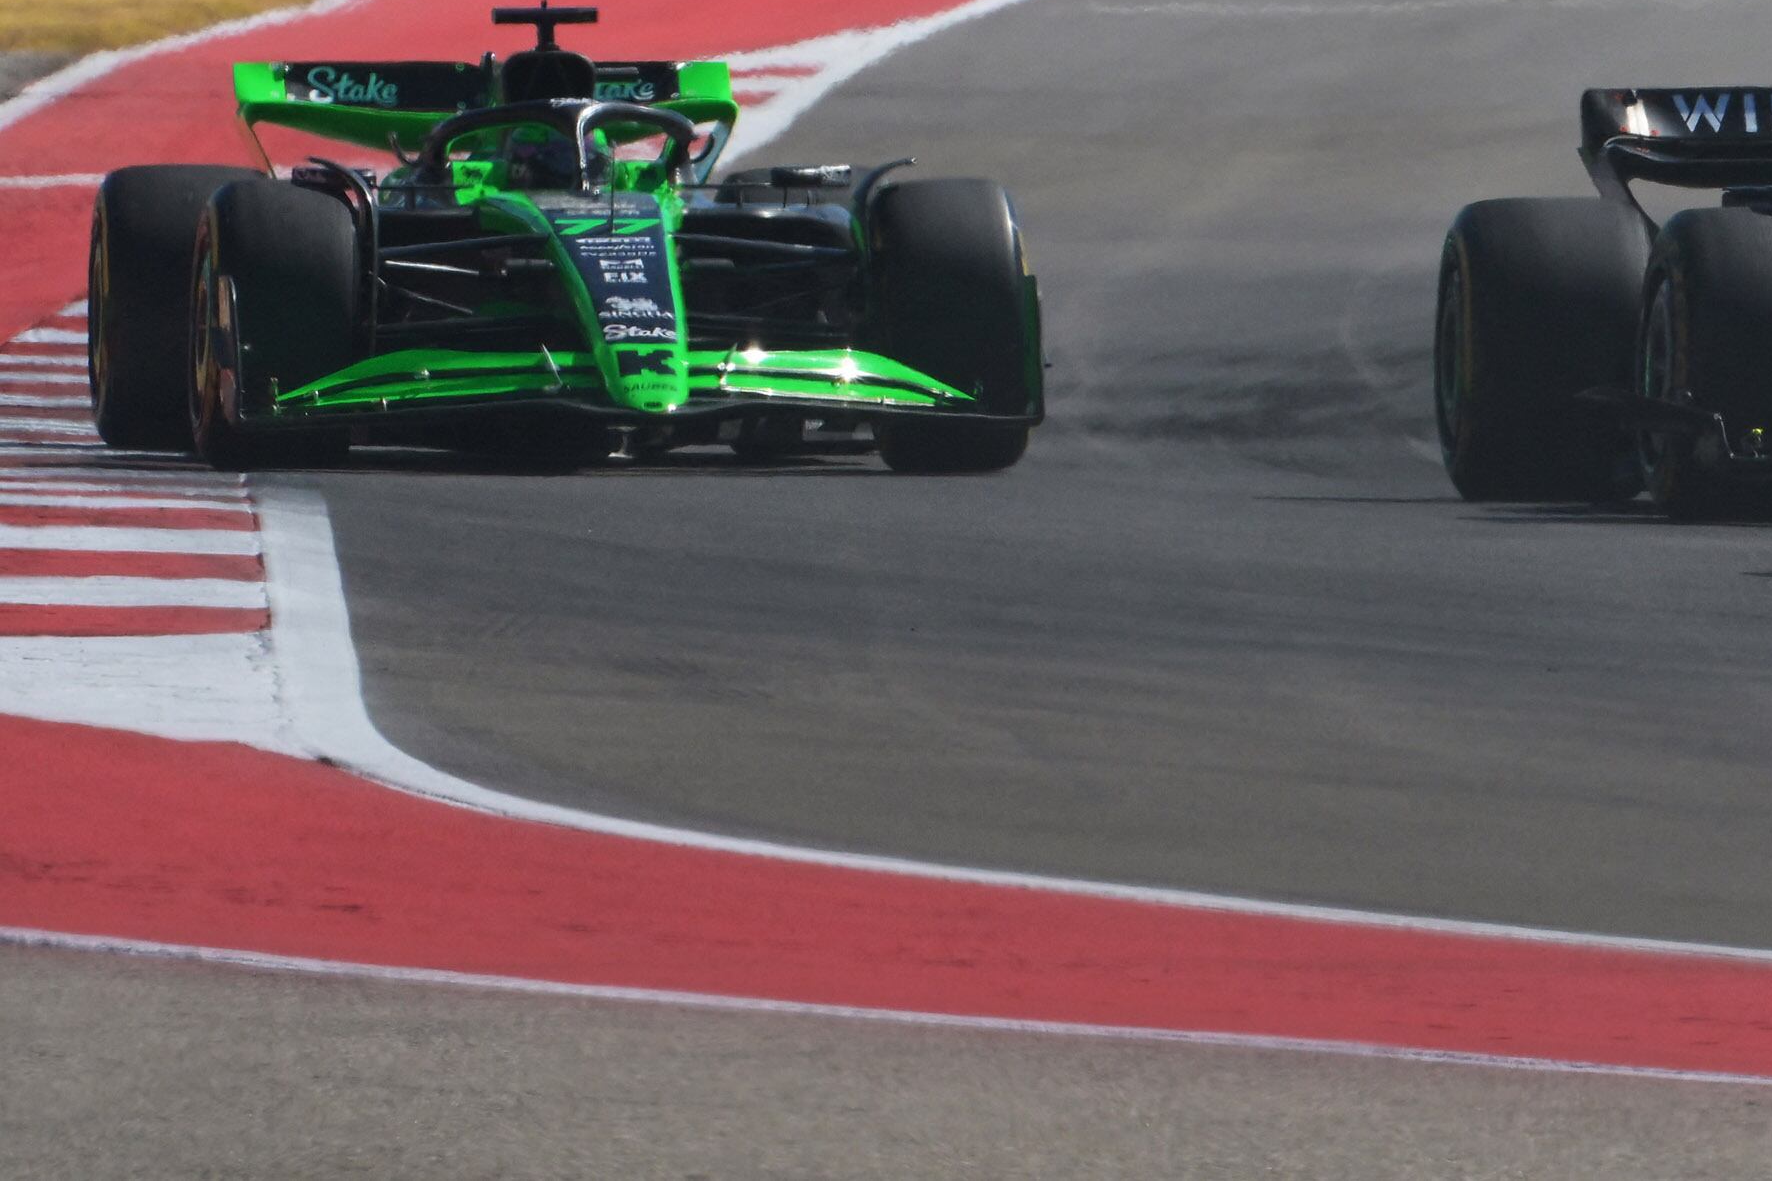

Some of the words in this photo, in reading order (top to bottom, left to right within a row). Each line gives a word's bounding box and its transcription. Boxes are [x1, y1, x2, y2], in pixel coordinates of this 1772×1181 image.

[307, 67, 398, 105] Stake
[554, 218, 660, 235] 77
[602, 323, 678, 340] Stake
